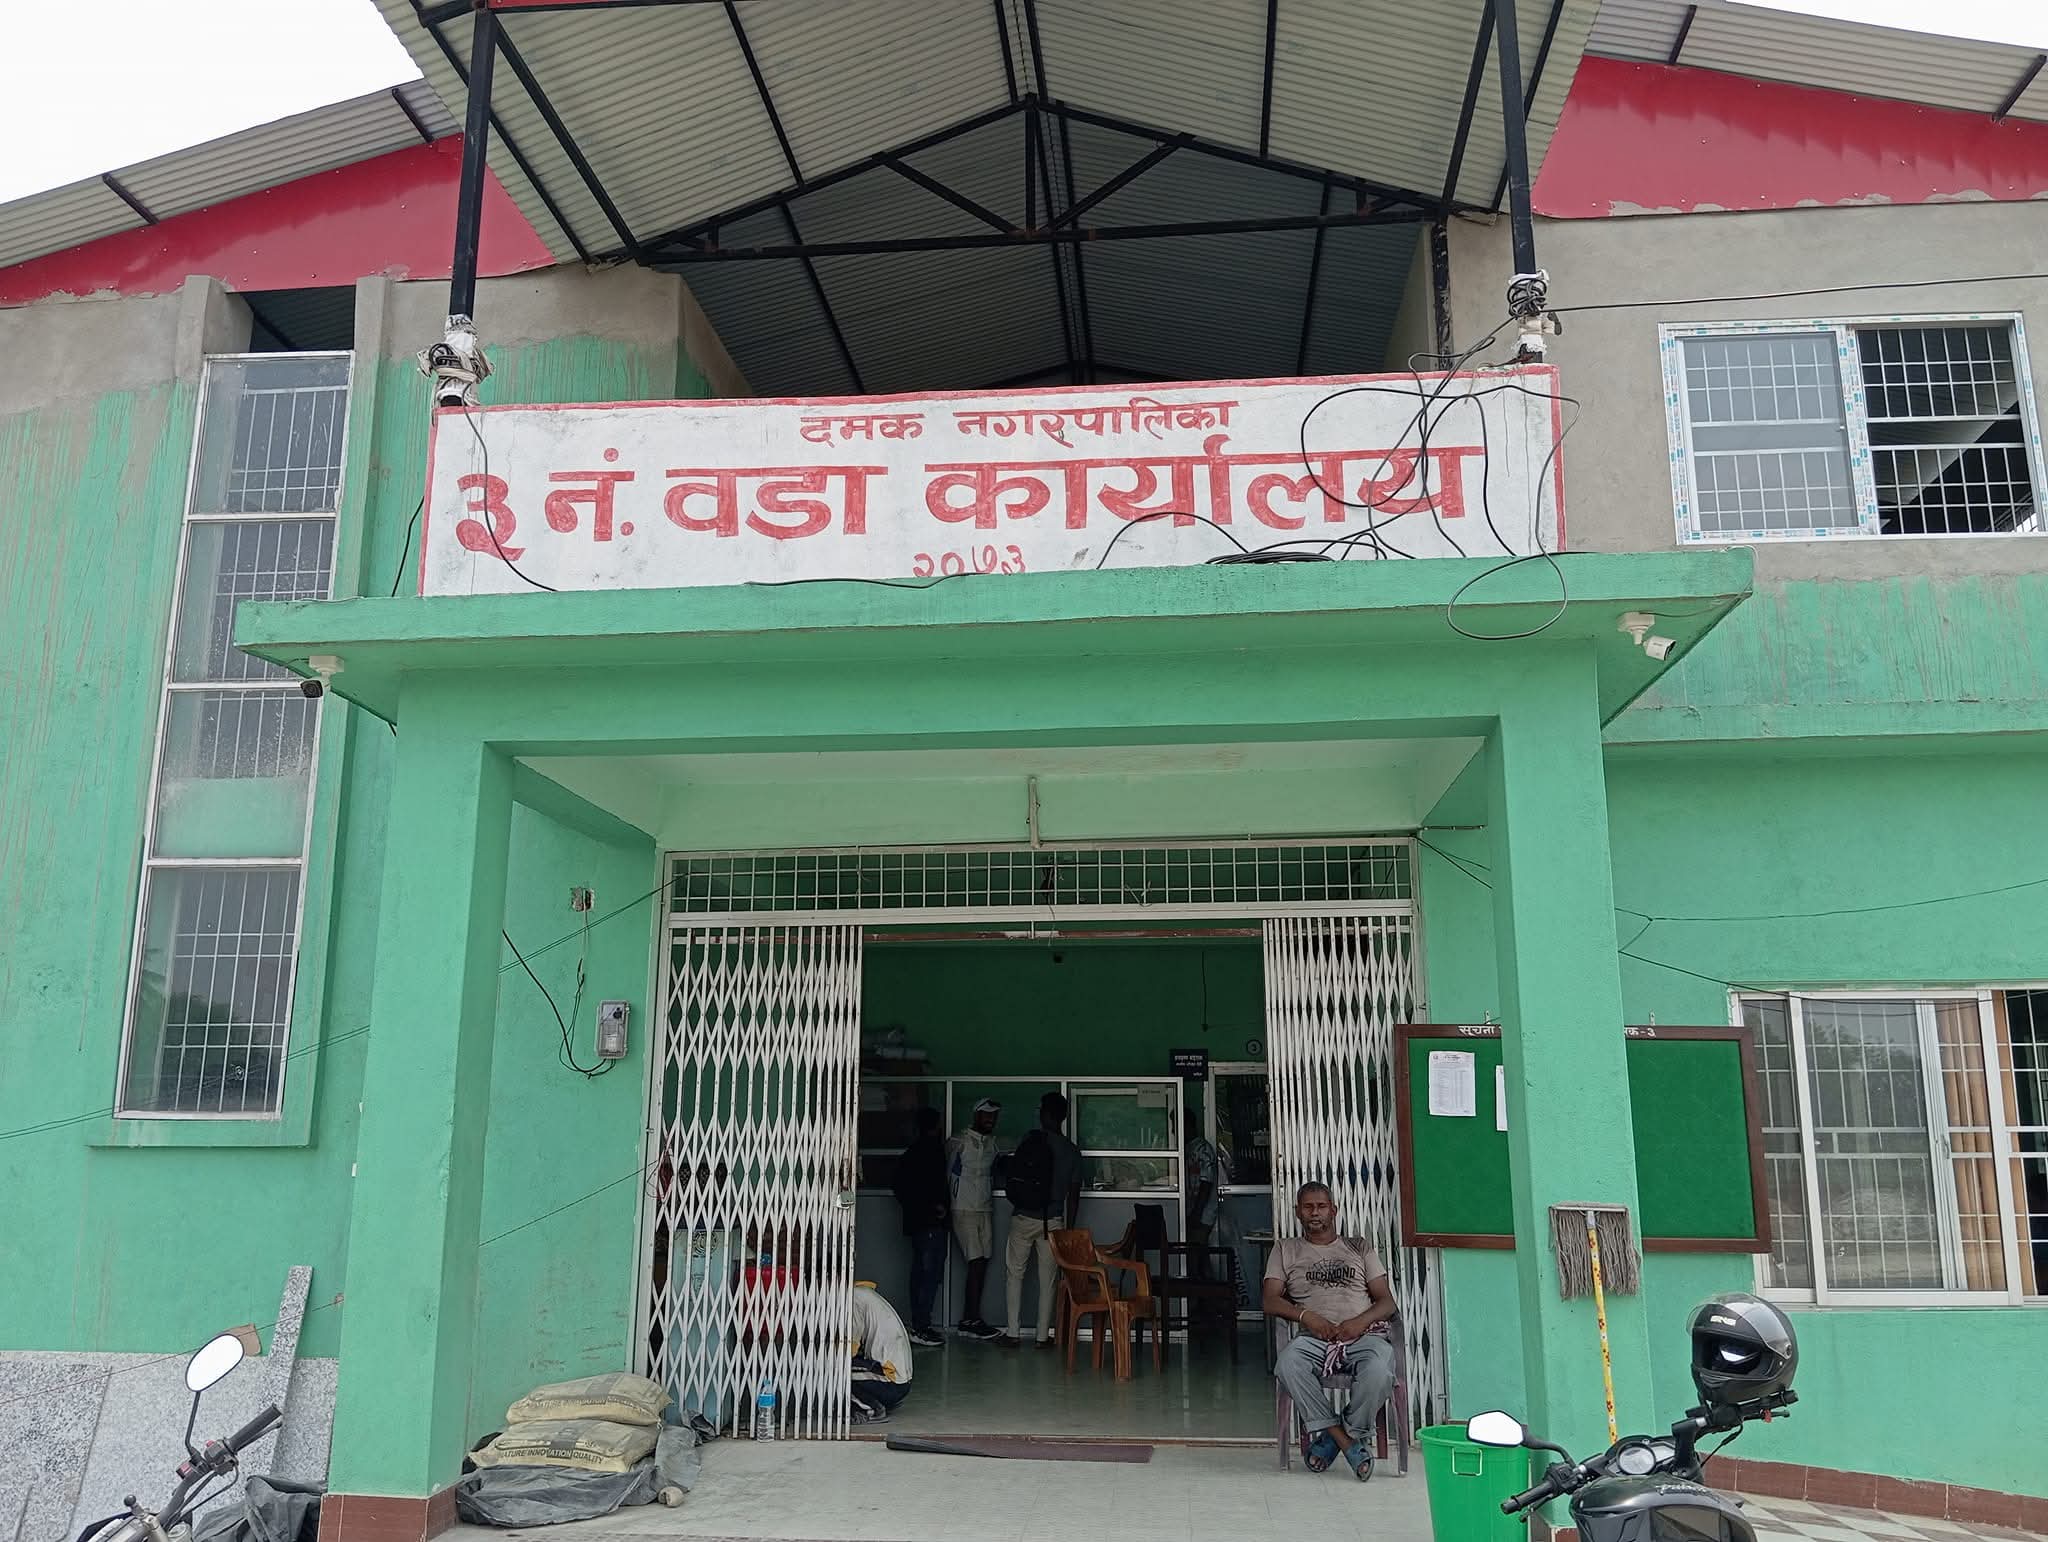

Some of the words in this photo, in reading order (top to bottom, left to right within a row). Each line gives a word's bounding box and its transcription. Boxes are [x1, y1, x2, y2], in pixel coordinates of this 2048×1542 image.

[799, 413, 925, 448] दमक
[953, 397, 1239, 448] नगरपालिका
[455, 473, 526, 561] ३
[545, 447, 635, 542] नं.
[663, 464, 889, 540] वडा
[925, 433, 1488, 530] कार्यालय
[913, 544, 1025, 576] २०७३
[1458, 1025, 1495, 1037] सूचना
[1305, 1265, 1356, 1281] RICHMOND
